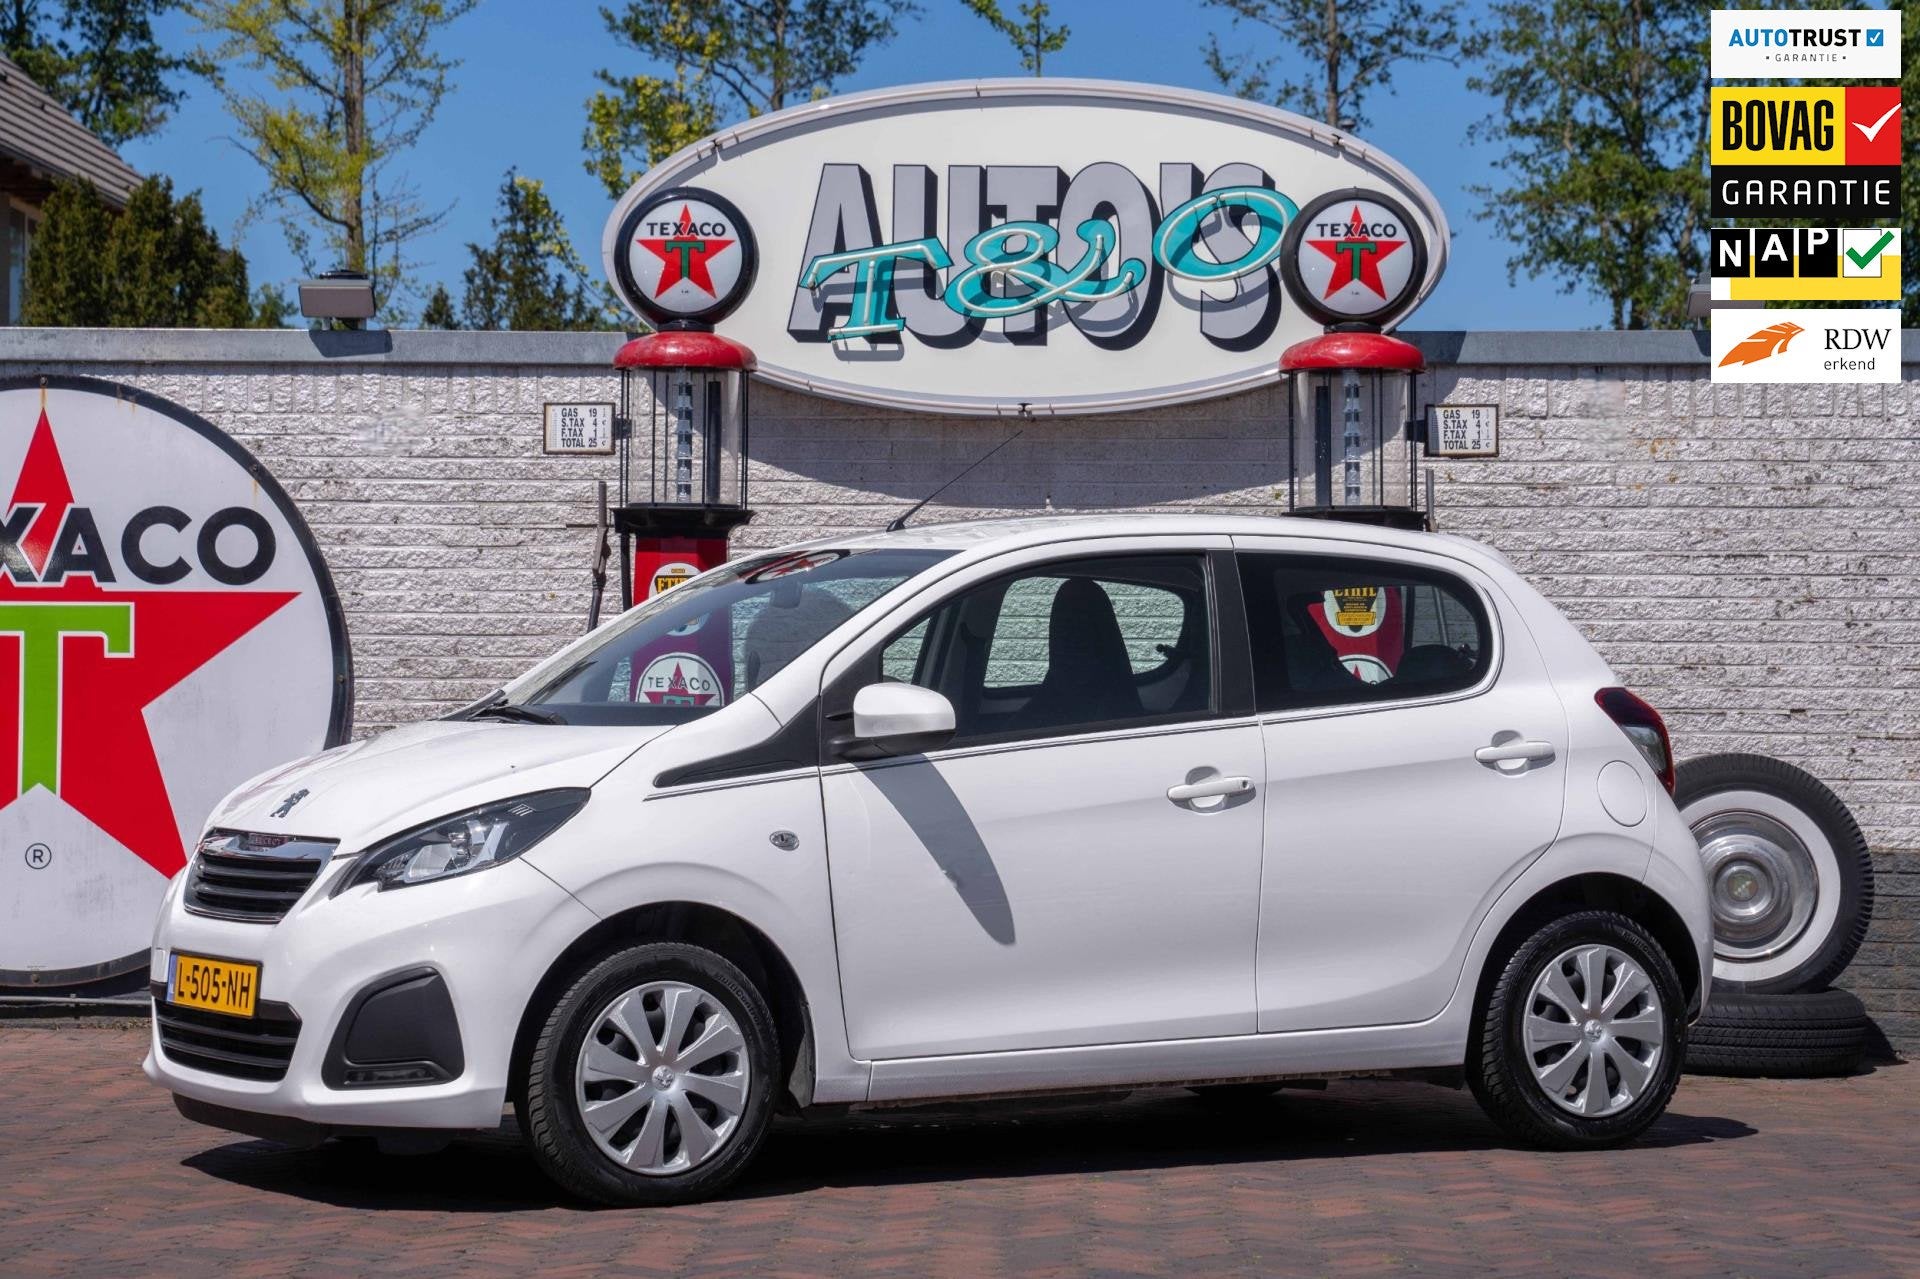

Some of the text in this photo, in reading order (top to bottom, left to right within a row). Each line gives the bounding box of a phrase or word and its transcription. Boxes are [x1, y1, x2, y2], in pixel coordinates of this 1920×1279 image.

[646, 222, 726, 237] TEXACO
[1316, 223, 1397, 238] TEXACO
[561, 408, 597, 417] GAS 19
[1443, 409, 1480, 419] GAS 19
[561, 418, 584, 427] S.TAX
[592, 418, 597, 427] 4
[1443, 419, 1467, 429] S.TAX
[1475, 420, 1480, 429] 4
[561, 428, 584, 437] F.TAX
[1443, 430, 1466, 439] F.TAX
[561, 438, 585, 448] TOTAL
[588, 438, 597, 448] 25
[1443, 440, 1469, 450] TOTAL
[1471, 440, 1481, 450] 25
[648, 676, 711, 691] TEXACO
[177, 961, 251, 1009] L-505-NH
